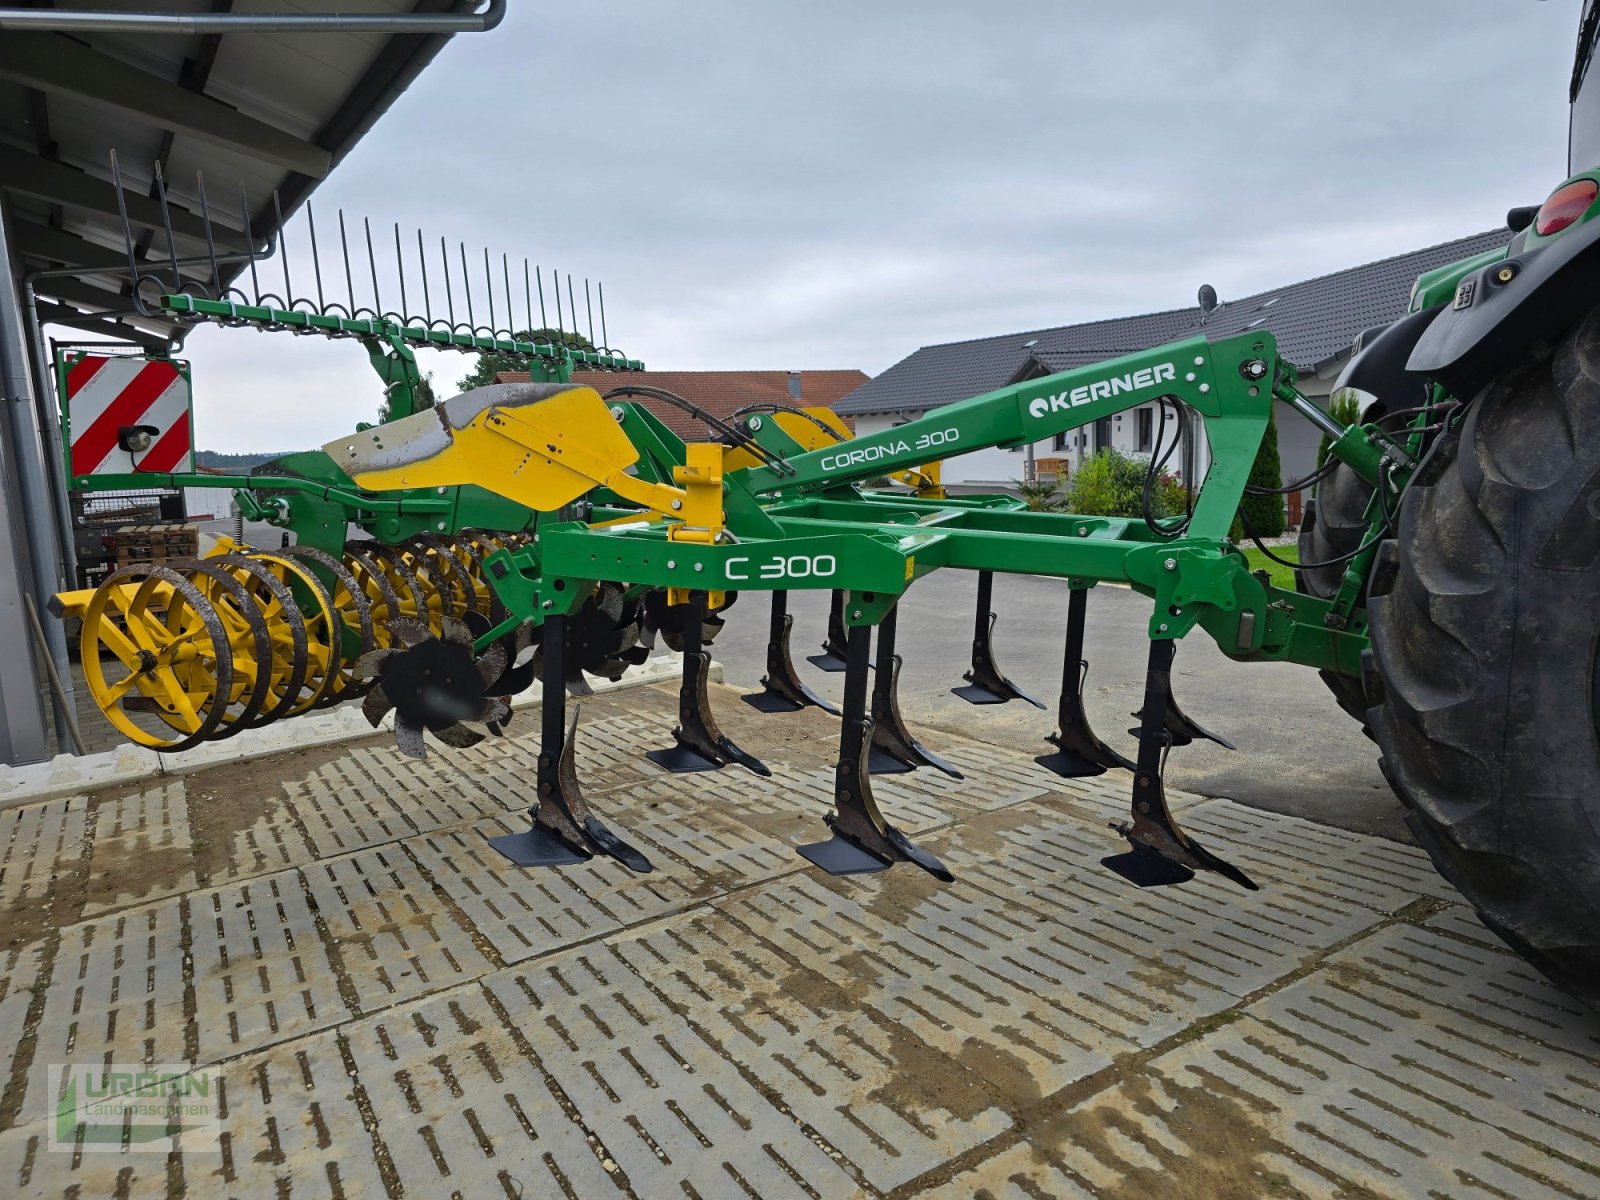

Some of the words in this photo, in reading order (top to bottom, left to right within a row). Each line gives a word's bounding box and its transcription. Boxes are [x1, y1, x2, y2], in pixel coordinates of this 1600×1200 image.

[1048, 362, 1176, 413] KERNER
[821, 440, 911, 471] CORONA
[915, 428, 960, 450] 300
[725, 557, 749, 580] C
[760, 555, 836, 579] 300
